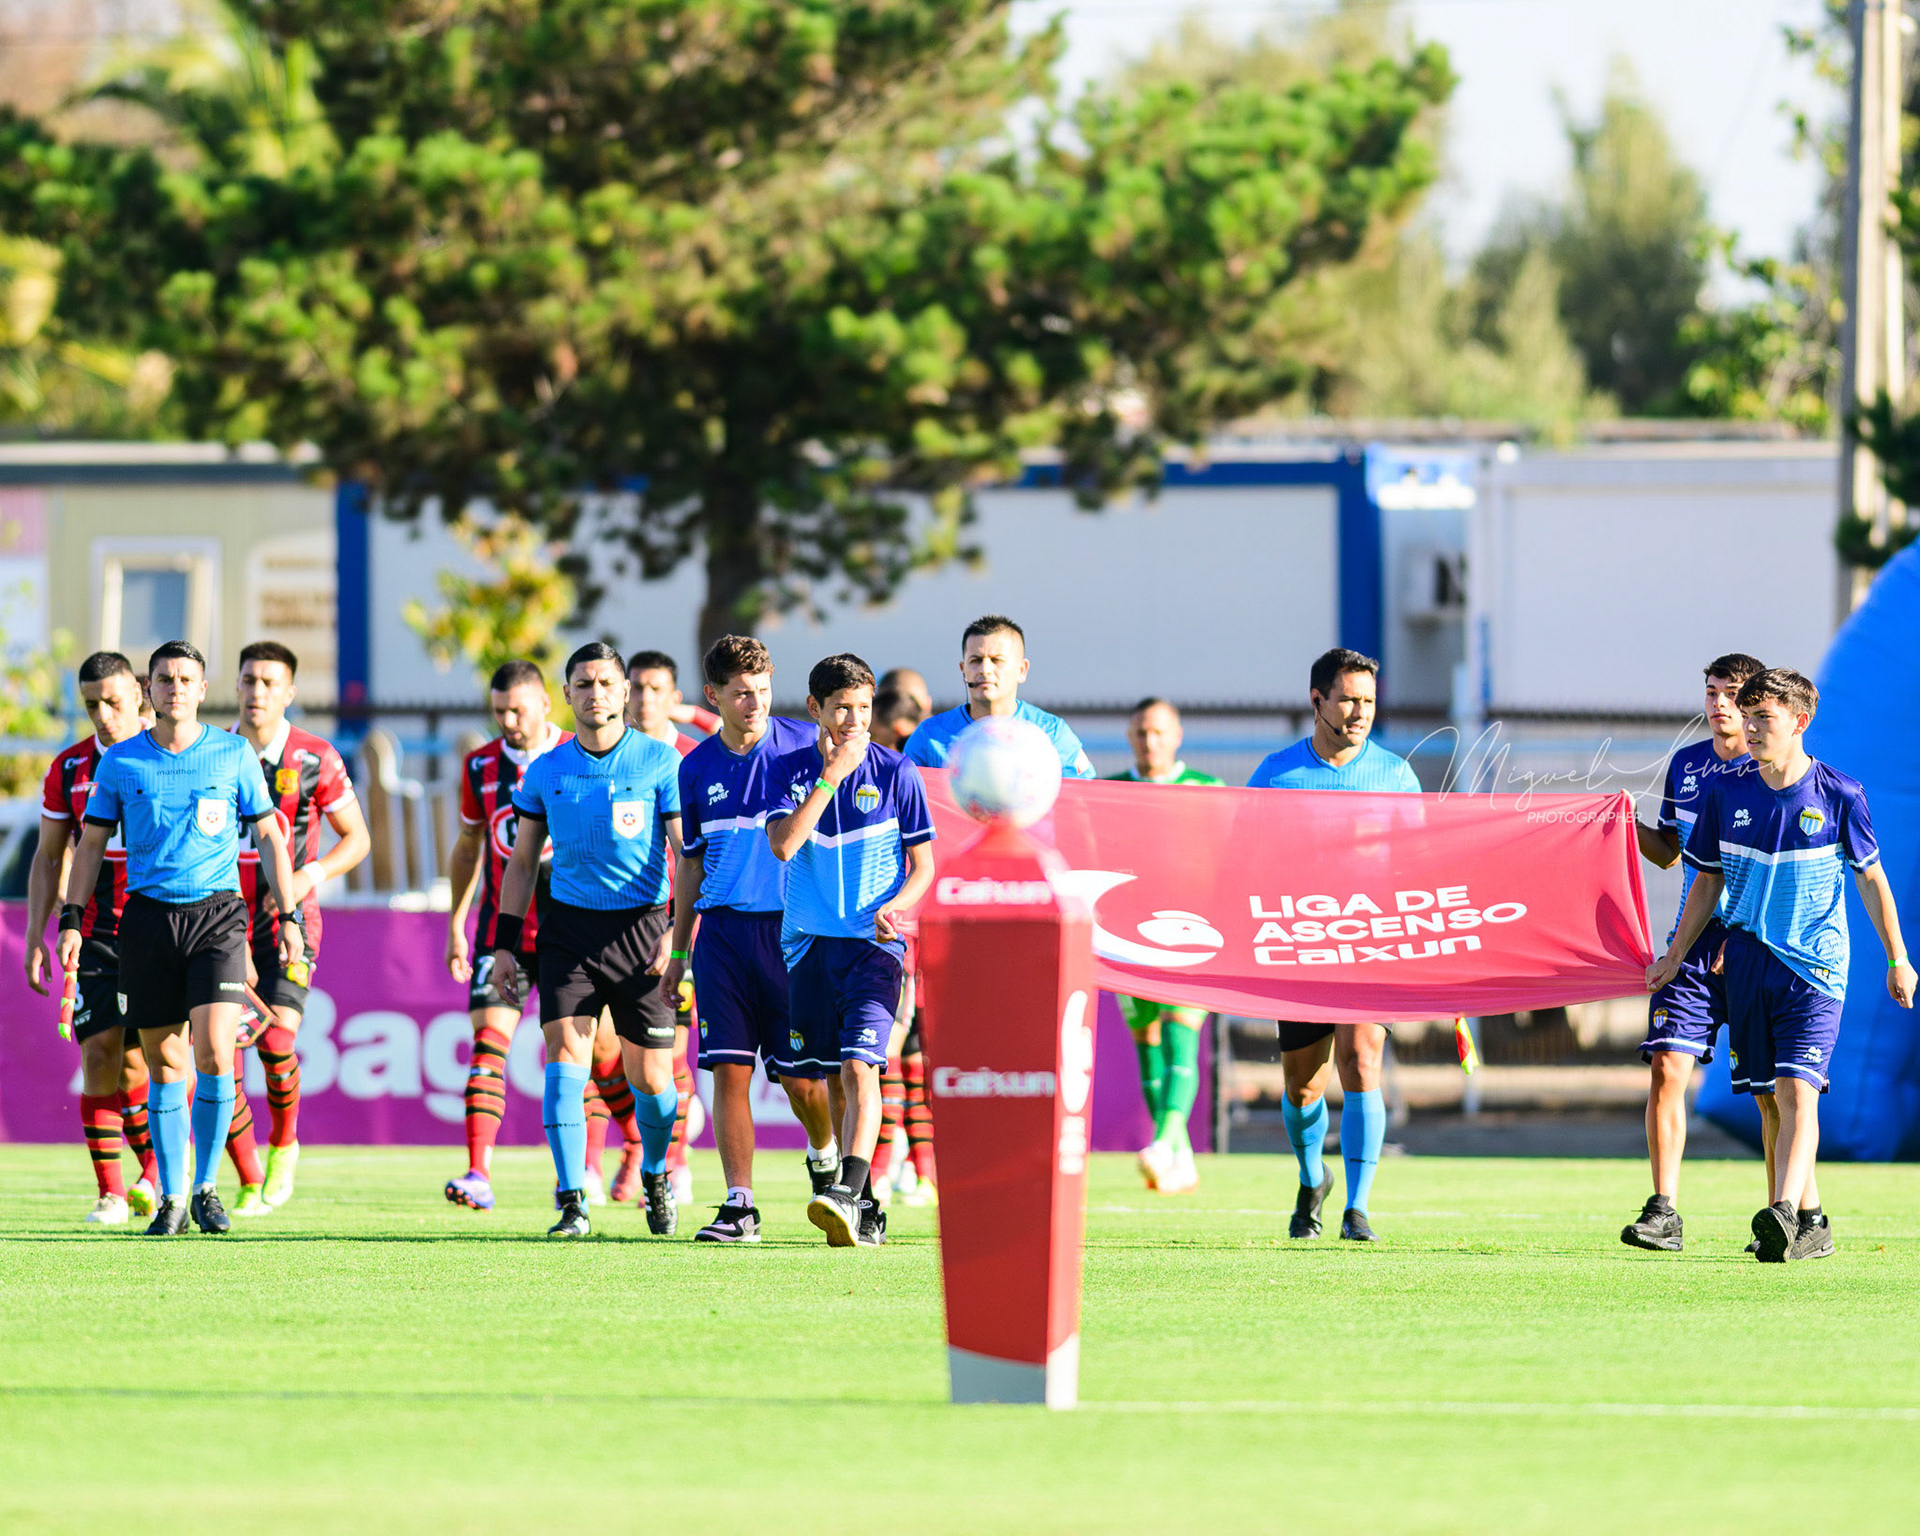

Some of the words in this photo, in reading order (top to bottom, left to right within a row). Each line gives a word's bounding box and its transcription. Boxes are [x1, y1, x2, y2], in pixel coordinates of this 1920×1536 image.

[1249, 893, 1383, 919] LIGA
[1394, 885, 1471, 912] DE
[1252, 902, 1528, 944] ASCENSO
[1253, 935, 1482, 966] Caixun
